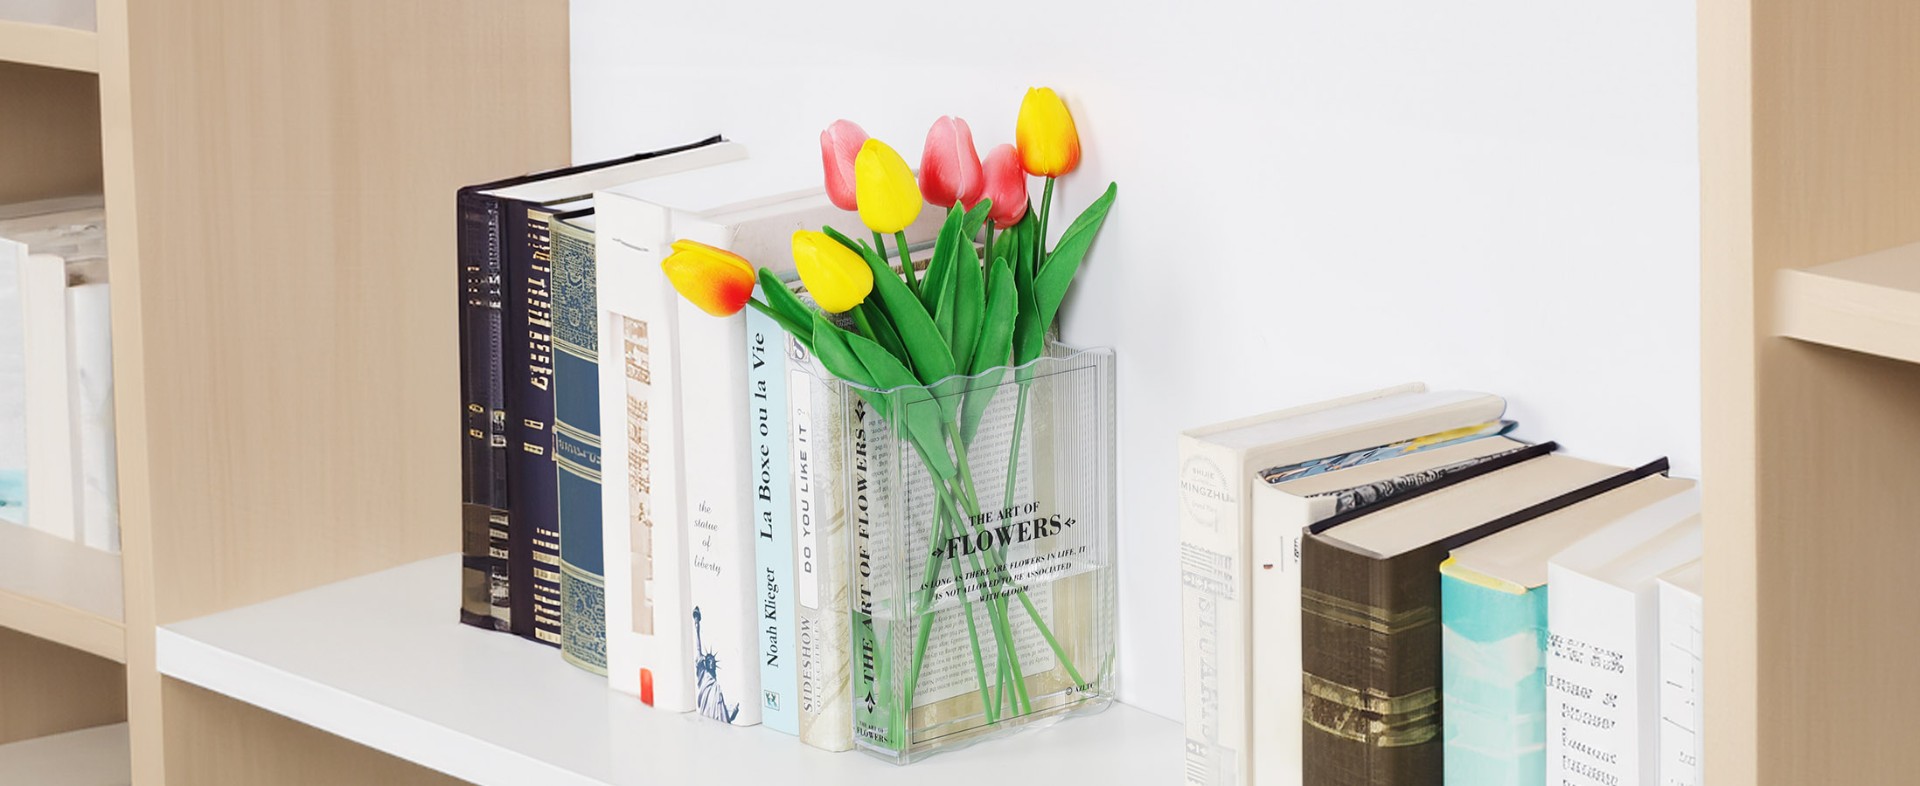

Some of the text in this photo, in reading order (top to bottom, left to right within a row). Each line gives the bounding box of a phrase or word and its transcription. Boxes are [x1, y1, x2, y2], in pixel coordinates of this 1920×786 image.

[752, 332, 773, 542] La Boxe ou la Vie
[798, 423, 807, 442] IT
[800, 450, 809, 493] LIKE
[698, 500, 712, 514] the
[1181, 480, 1230, 502] MINGZHU
[693, 518, 719, 532] statue
[802, 499, 811, 537] YOU
[968, 501, 1040, 527] THE ART OF
[702, 535, 711, 552] of
[946, 513, 1062, 560] FLOWERS
[803, 546, 812, 573] DO
[855, 427, 875, 685] THE ART OF FLOWERS
[920, 583, 929, 591] AS
[930, 577, 952, 589] LONG
[965, 568, 990, 580] THERE
[993, 564, 1007, 574] ARE
[1009, 556, 1045, 570] FLOWERS
[1046, 553, 1055, 561] IN
[1078, 545, 1086, 554] IT
[945, 588, 960, 598] NOT
[963, 579, 1001, 593] ALLOWED
[1001, 576, 1012, 585] TO
[1013, 573, 1024, 582] BE
[1027, 562, 1072, 578] ASSOCIATED
[979, 592, 999, 602] WITH
[764, 566, 779, 669] Noah Klieger
[801, 615, 813, 713] SIDESHOW
